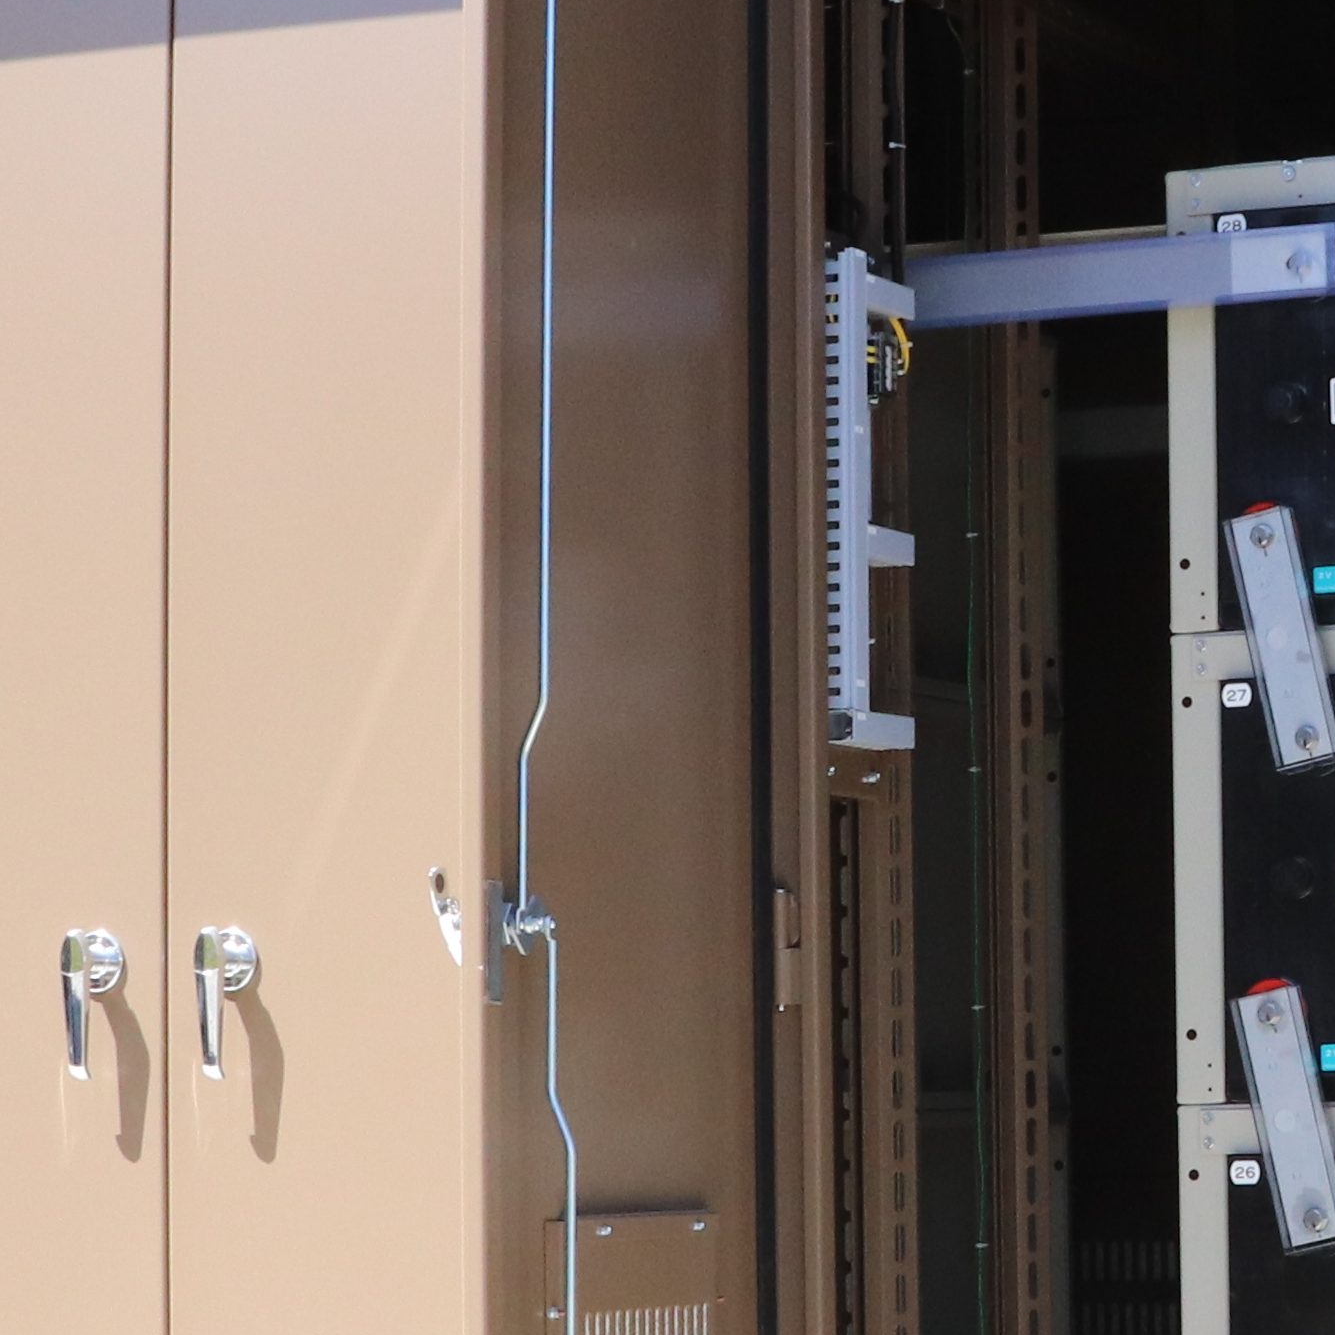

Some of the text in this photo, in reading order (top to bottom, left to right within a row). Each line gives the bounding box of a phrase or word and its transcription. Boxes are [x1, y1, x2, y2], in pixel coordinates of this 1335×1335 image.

[1222, 220, 1243, 233] 28
[1226, 688, 1247, 703] 27
[1235, 1166, 1256, 1179] 26
